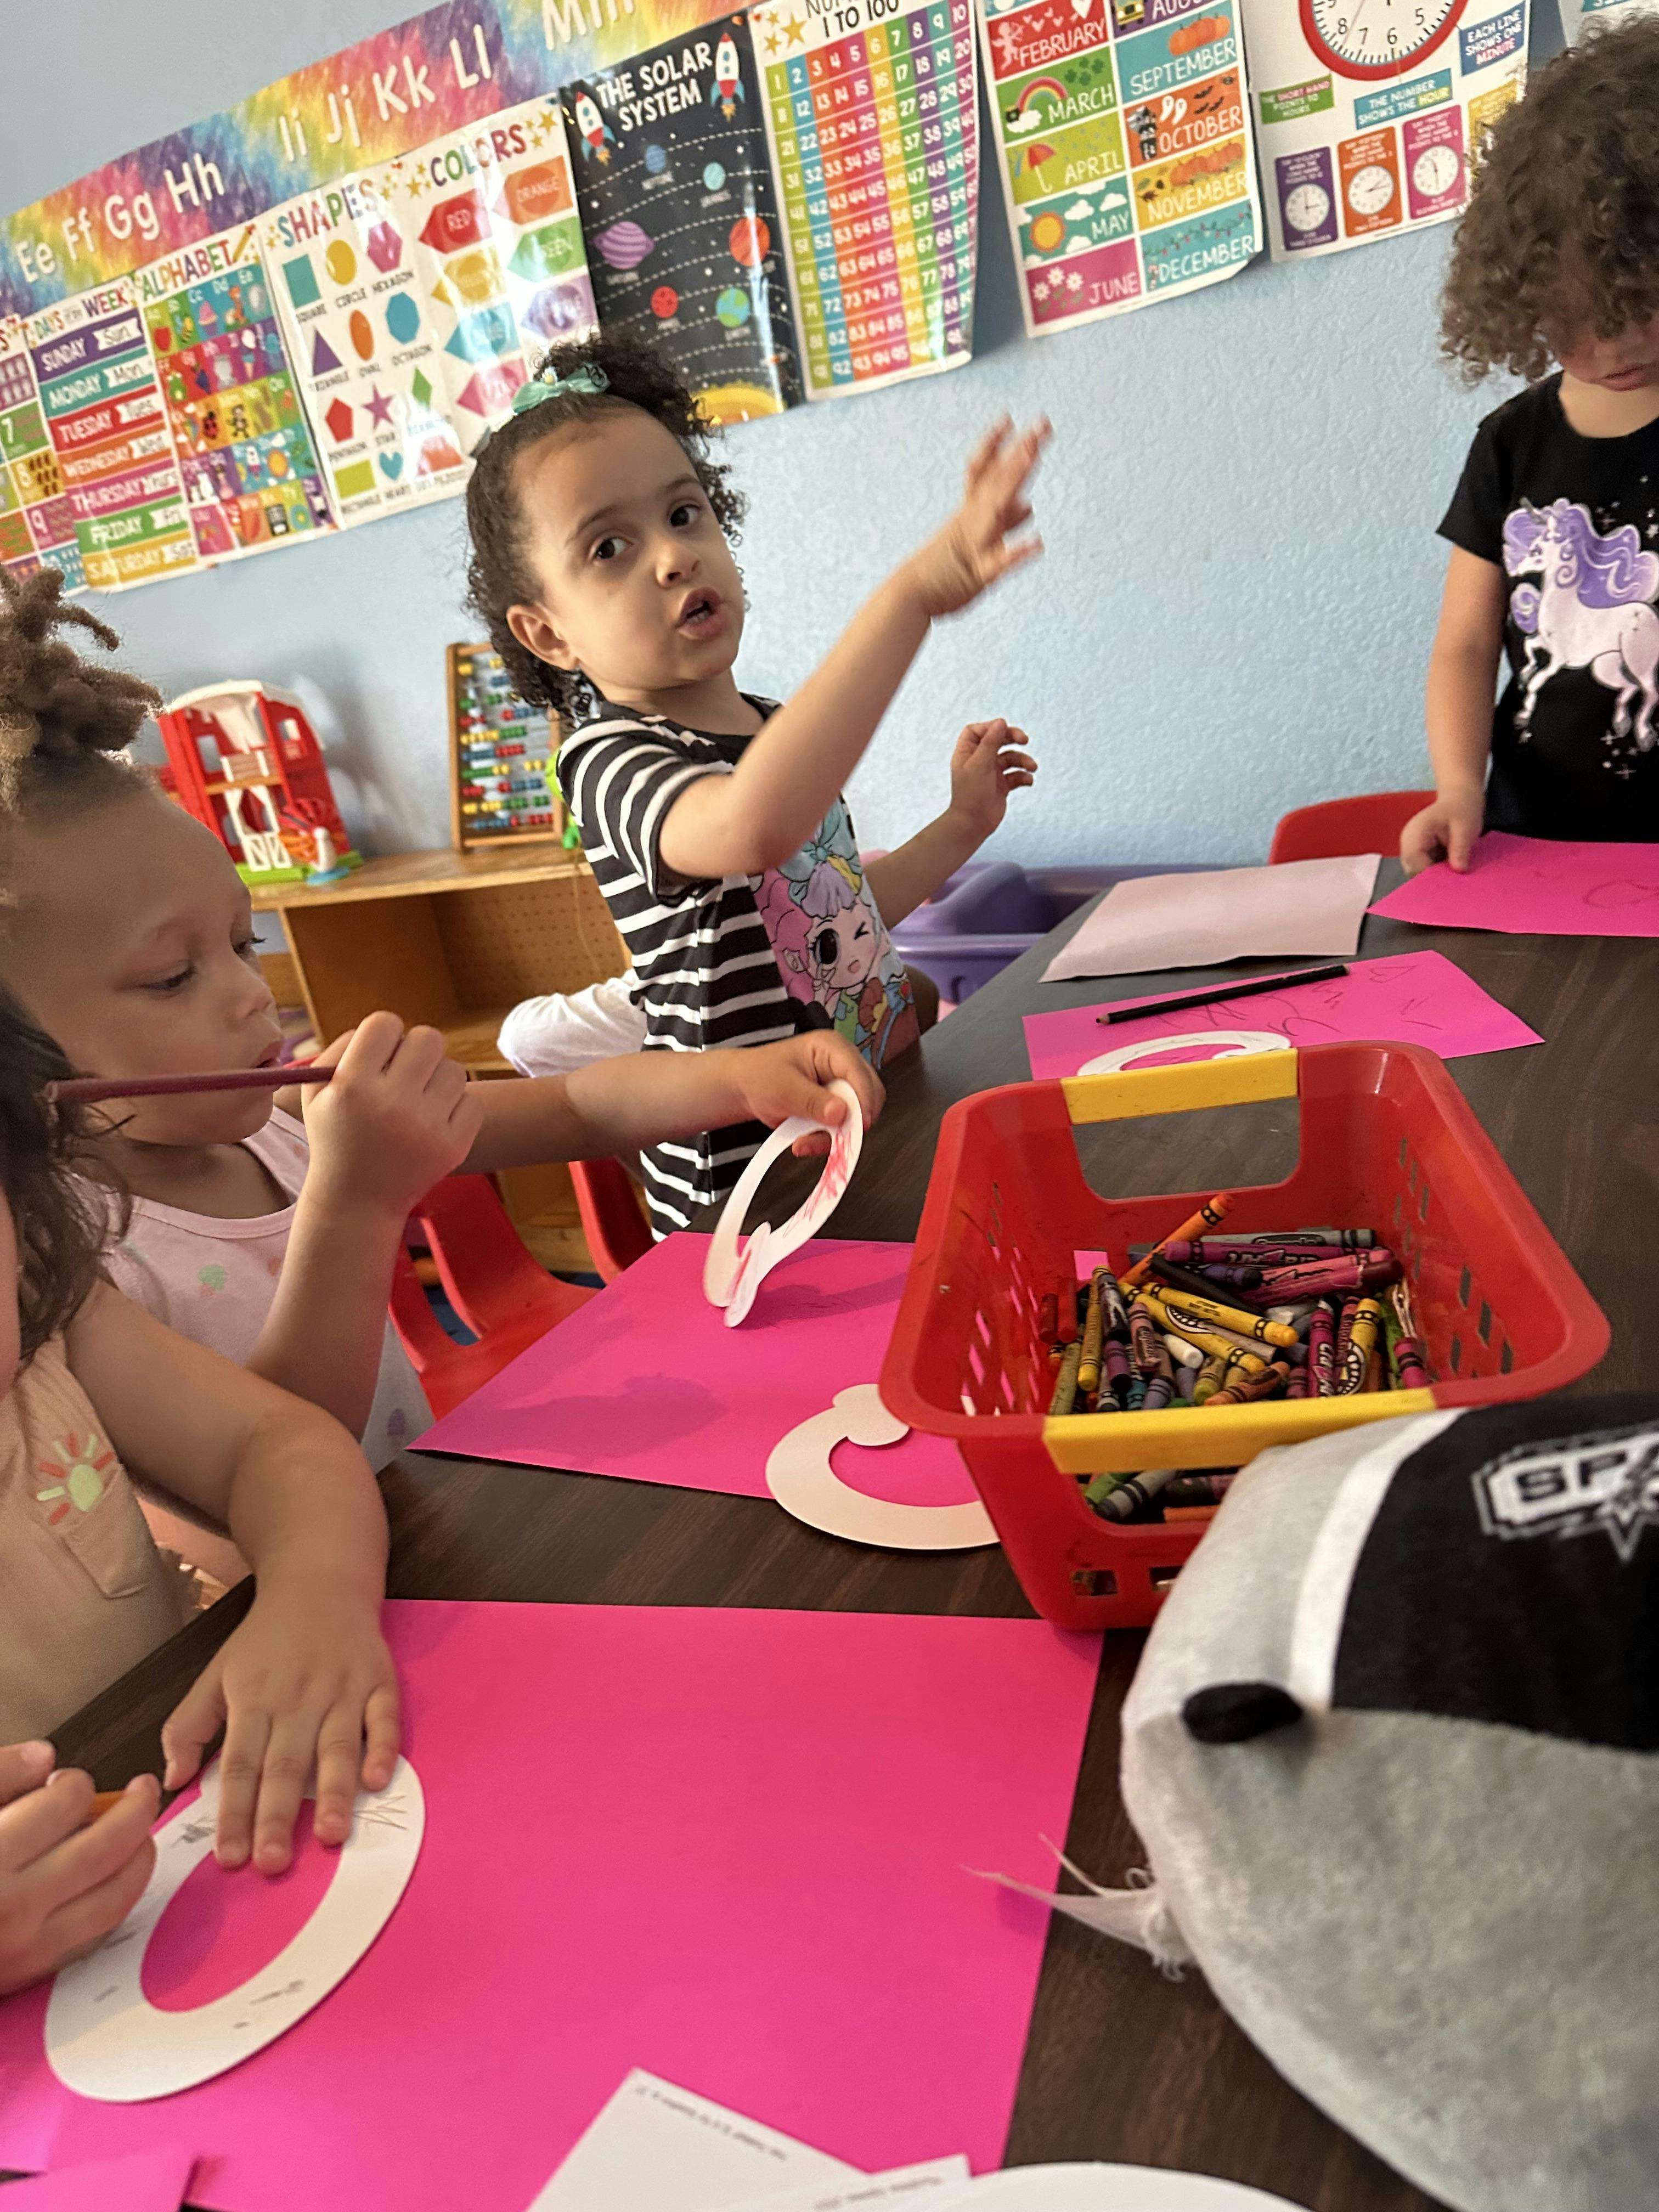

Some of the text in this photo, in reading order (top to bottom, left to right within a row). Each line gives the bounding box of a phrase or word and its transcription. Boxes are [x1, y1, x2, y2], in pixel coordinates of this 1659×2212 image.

[834, 6, 860, 33] TO
[1338, 17, 1348, 35] 8
[1415, 7, 1425, 25] 5
[1467, 9, 1522, 43] EACH LINE
[775, 4, 966, 89] 1 2 3 4 5 6 7 8 9 10
[1019, 18, 1106, 67] FEBRUARY
[1358, 27, 1368, 45] 7
[1387, 27, 1398, 45] 6
[1465, 20, 1523, 56] SHOWS ONE
[1476, 38, 1516, 65] MINUTE
[596, 41, 713, 109] THE SOLAR
[796, 100, 810, 117] 12
[817, 93, 830, 110] 13
[835, 87, 849, 104] 14
[854, 79, 868, 97] 15
[896, 64, 907, 82] 17
[916, 57, 930, 74] 18
[936, 48, 951, 66] 19
[955, 38, 972, 59] 20
[1130, 38, 1236, 95] SEPTEMBER
[618, 78, 702, 131] SYSTEM
[1047, 83, 1114, 123] MARCH
[1368, 79, 1436, 109] THE NUMBER
[800, 133, 818, 151] 22
[820, 127, 837, 145] 23
[839, 120, 857, 138] 24
[859, 112, 876, 131] 25
[900, 98, 916, 116] 27
[919, 91, 937, 109] 28
[939, 82, 957, 102] 29
[1358, 106, 1396, 125] SHOWS
[1397, 98, 1417, 111] THE
[1159, 105, 1242, 153] OCTOBER
[16, 240, 55, 283] Ee
[62, 207, 94, 262] Ff
[104, 191, 160, 241] Gg
[165, 153, 225, 213] Hh
[279, 107, 307, 162] Ii
[326, 84, 360, 148] Jj
[373, 55, 436, 121] Kk
[449, 24, 492, 89] Ll
[431, 123, 527, 187] COLORS
[1064, 150, 1123, 185] APRIL
[278, 179, 379, 247] SHAPES
[1147, 171, 1248, 222] NOVEMBER
[446, 208, 472, 233] RED
[1091, 210, 1129, 240] MAY
[143, 239, 232, 301] ALPHABET
[1158, 234, 1254, 283] DECEMBER
[82, 287, 128, 318] WEEK
[335, 287, 368, 309] CIRCLE
[1089, 272, 1139, 304] JUNE
[42, 337, 87, 372] SUNDAY
[49, 373, 102, 409] MONDAY
[1, 417, 14, 444] 7
[58, 409, 114, 443] TUESDAY
[71, 479, 144, 512] THURSDAY
[31, 509, 48, 535] 9
[90, 516, 144, 545] FRIDAY
